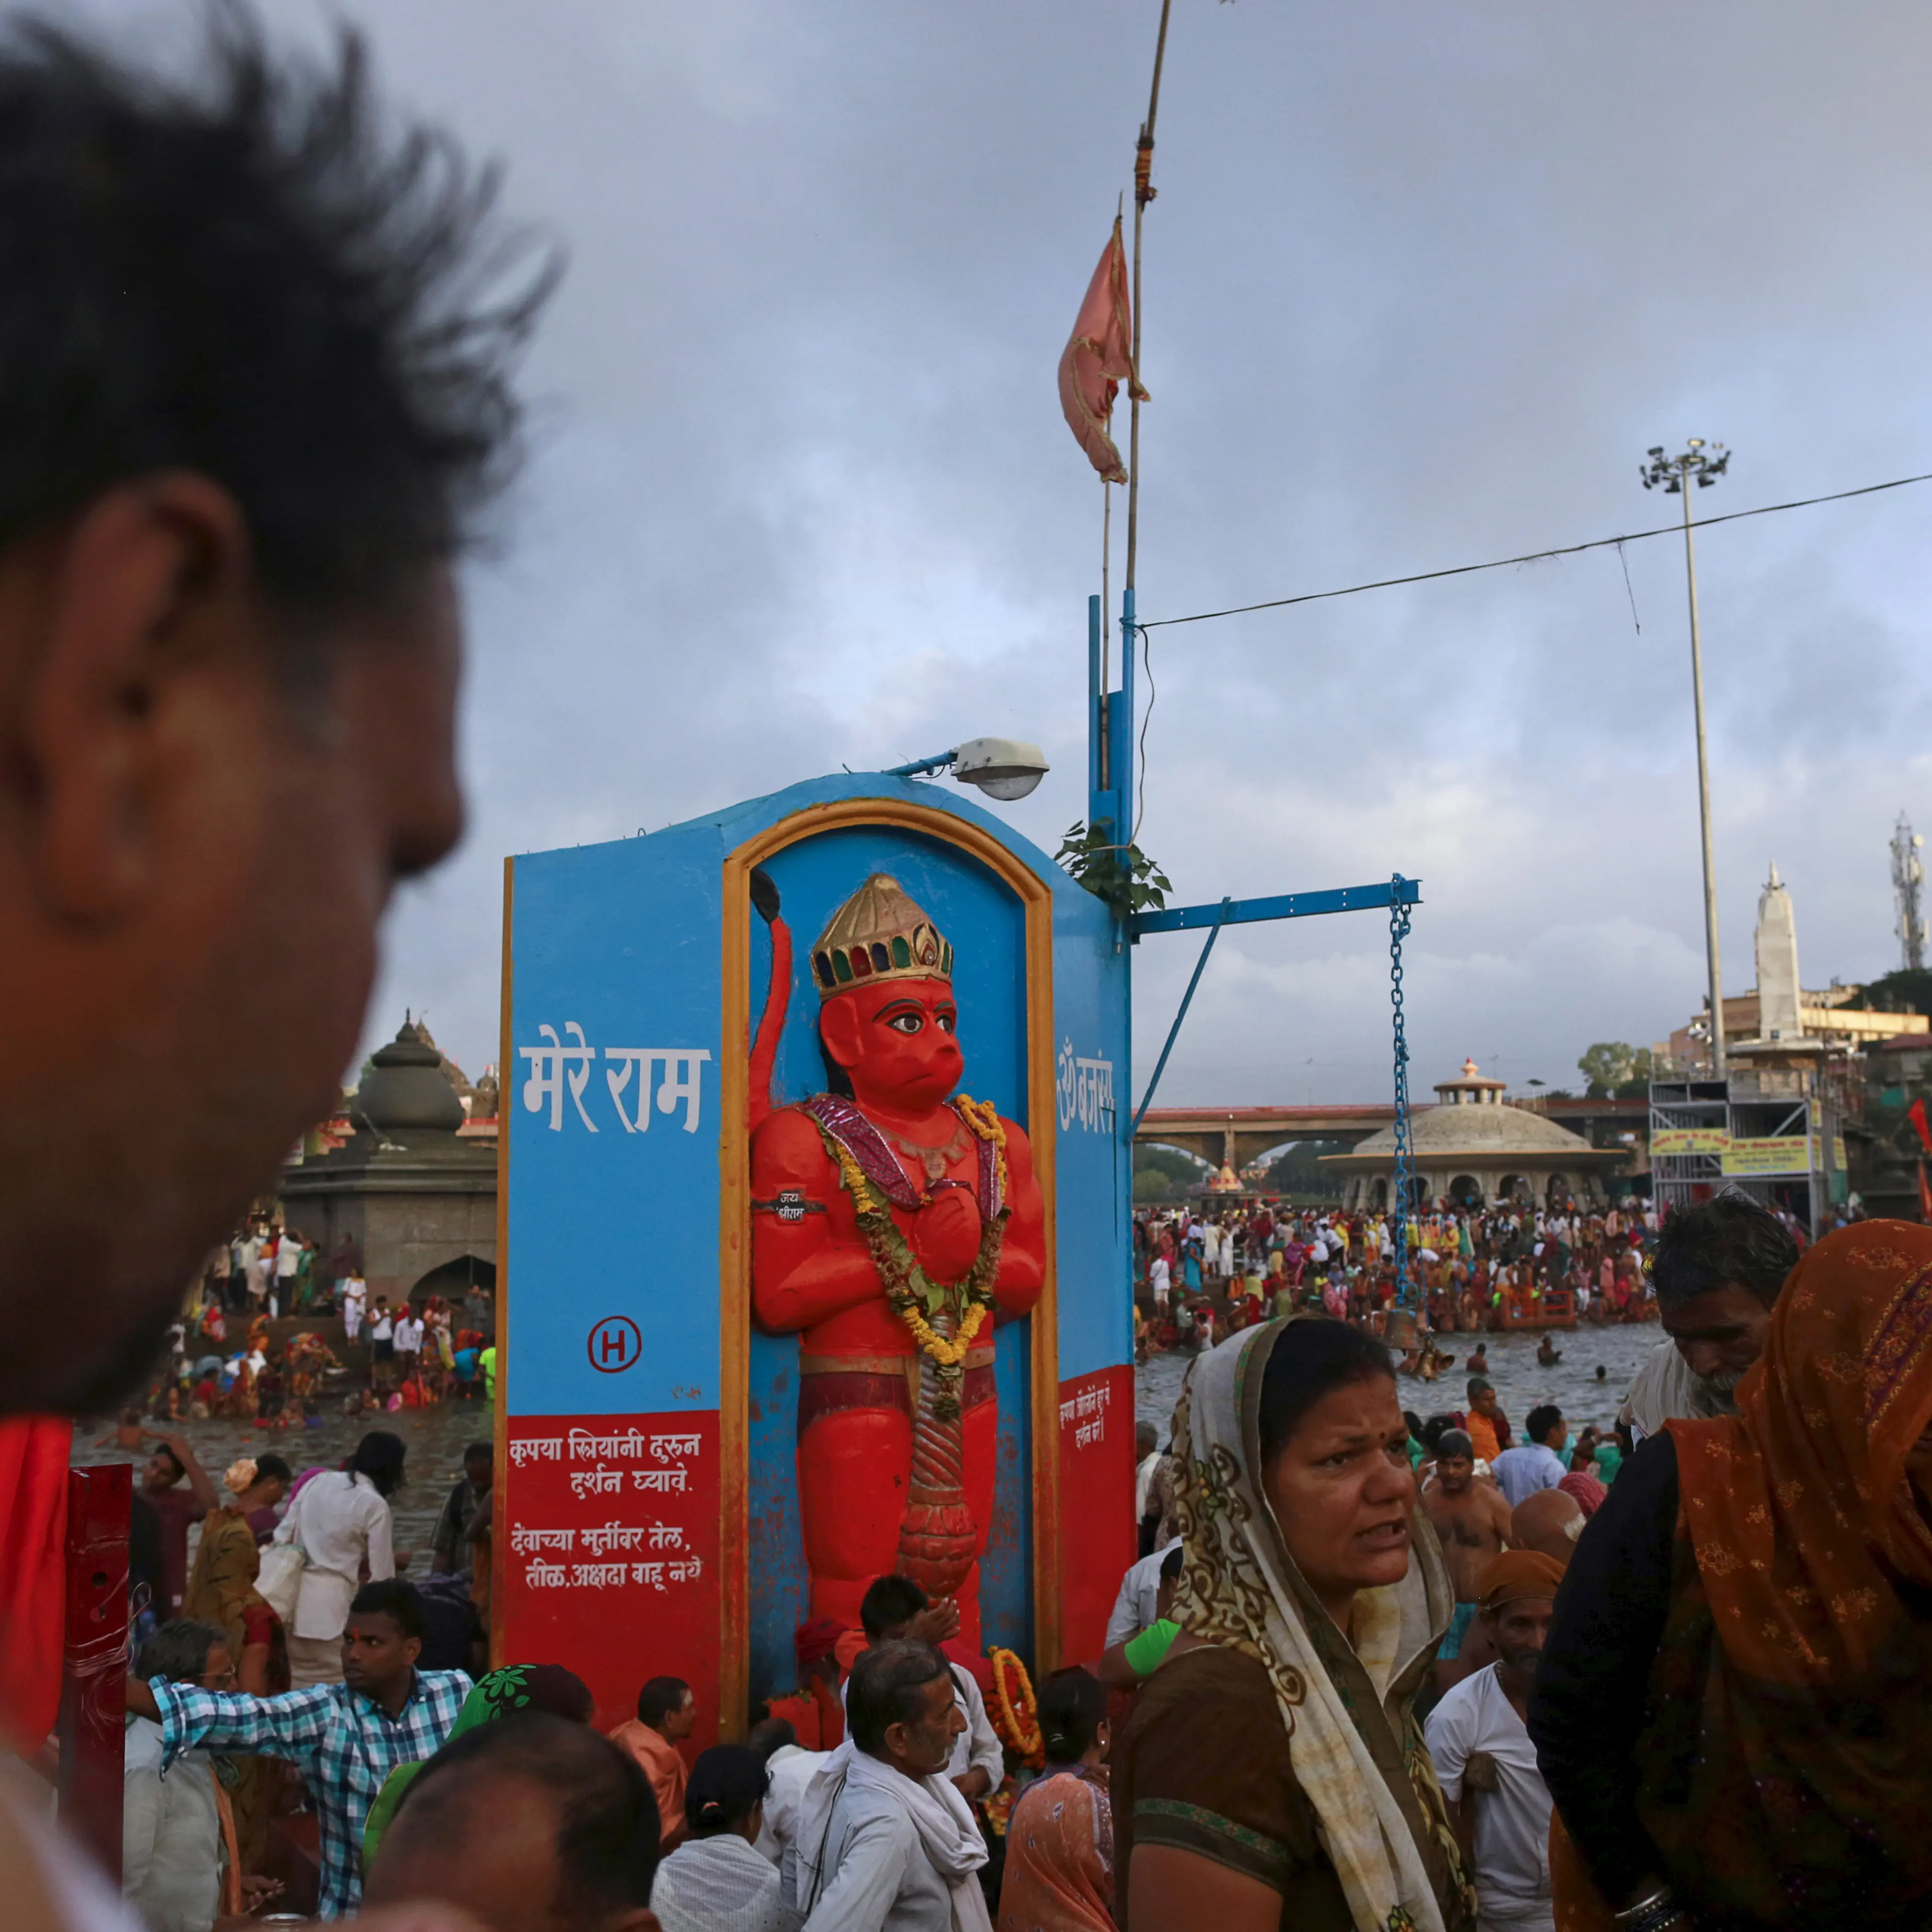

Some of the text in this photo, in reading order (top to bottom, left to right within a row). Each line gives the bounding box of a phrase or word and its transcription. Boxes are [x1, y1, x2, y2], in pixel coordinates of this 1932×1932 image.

[518, 1021, 712, 1134] मेरे राम
[780, 1193, 799, 1203] जय
[510, 1438, 563, 1468] कृपया
[570, 1463, 623, 1500] दर्शन
